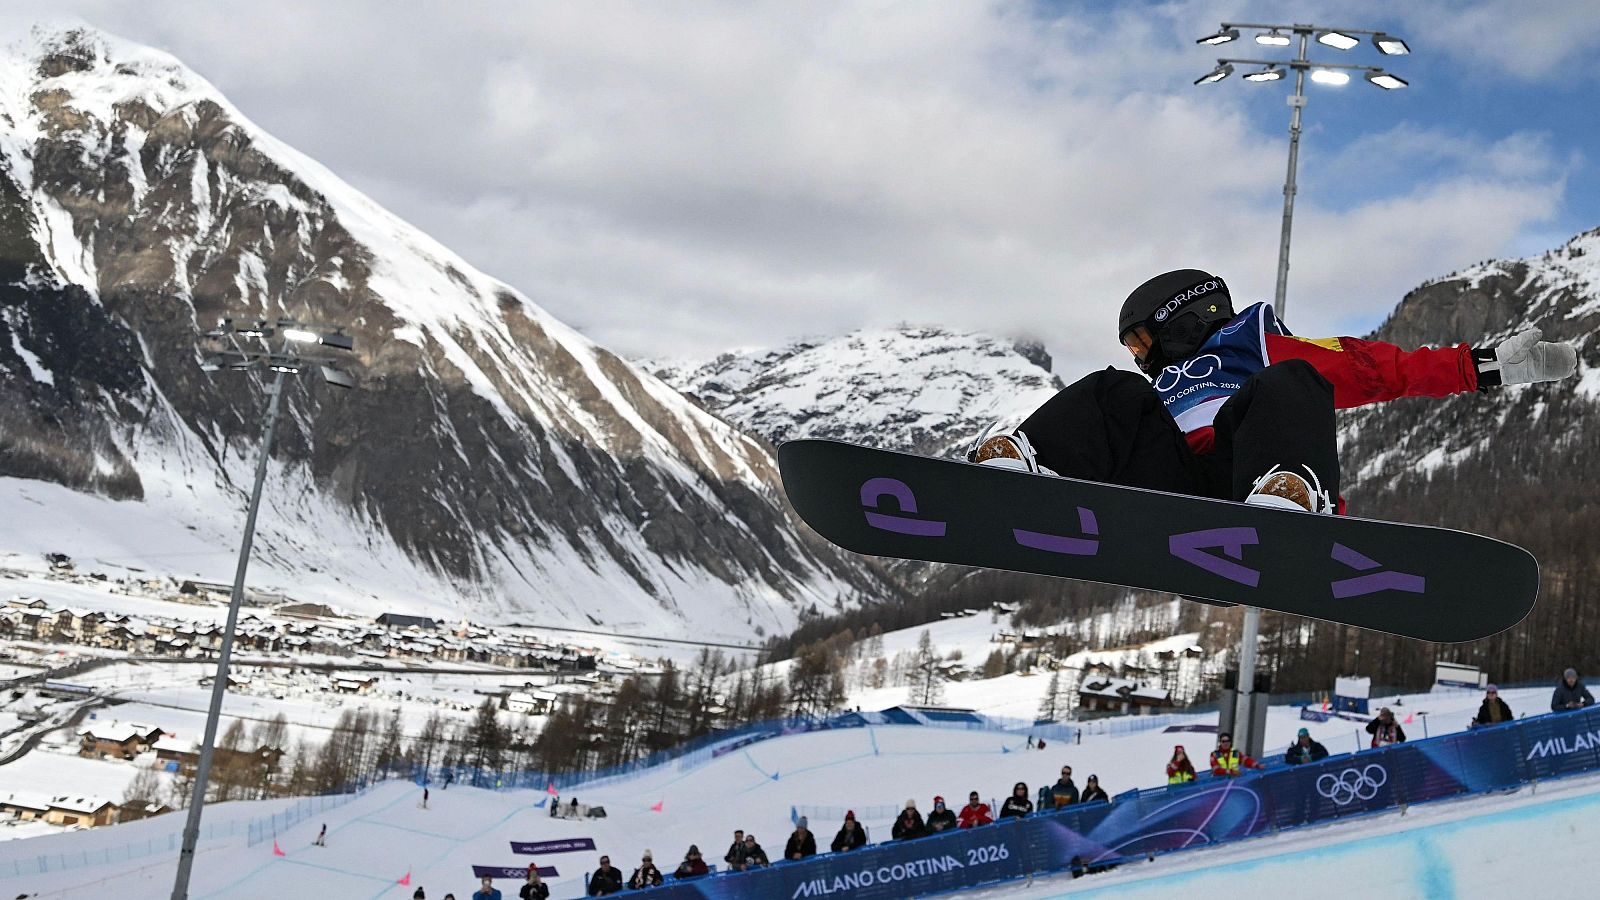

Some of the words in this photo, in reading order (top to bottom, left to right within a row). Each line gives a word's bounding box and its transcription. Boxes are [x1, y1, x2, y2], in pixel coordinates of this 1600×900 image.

[1165, 280, 1224, 312] DRAGON
[1177, 381, 1219, 399] CORTINA
[1220, 382, 1241, 390] 2026
[860, 477, 1426, 599] PLAY
[792, 870, 874, 900] MILANO
[877, 855, 965, 883] CORTINA
[967, 843, 1009, 866] 2026
